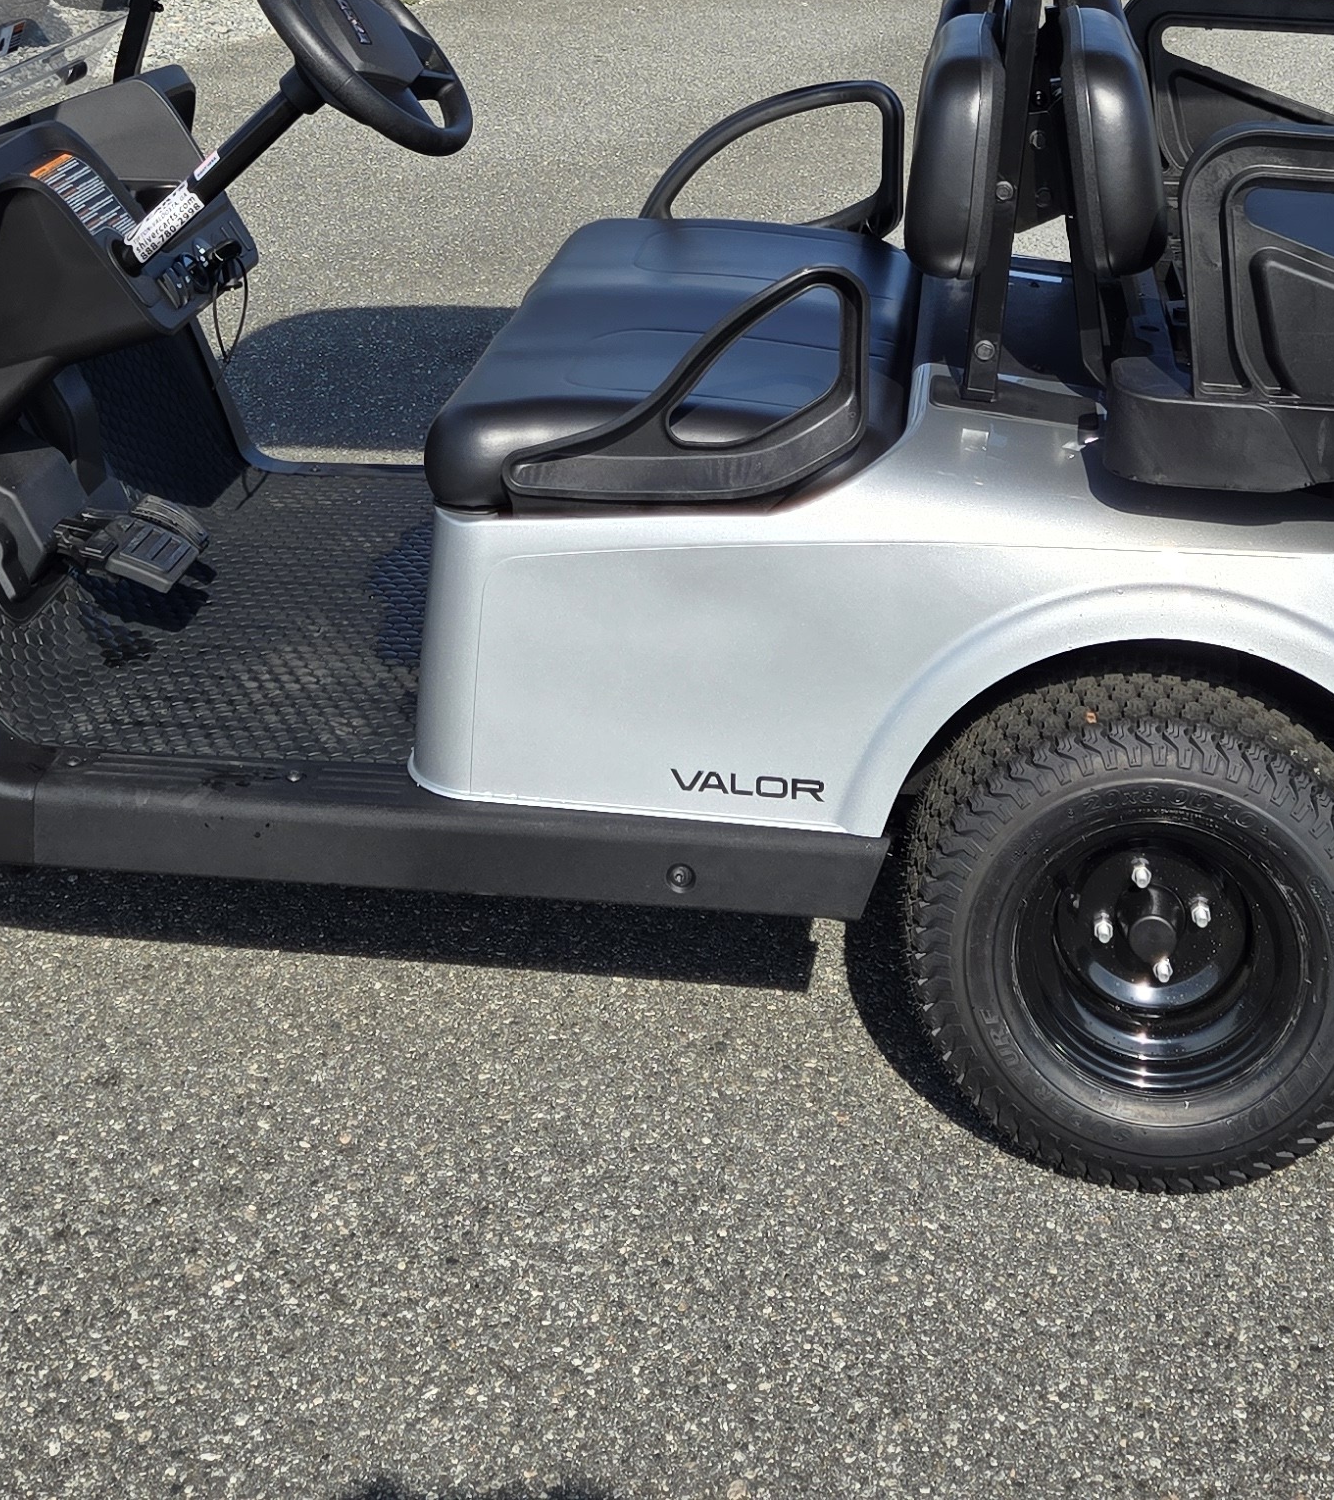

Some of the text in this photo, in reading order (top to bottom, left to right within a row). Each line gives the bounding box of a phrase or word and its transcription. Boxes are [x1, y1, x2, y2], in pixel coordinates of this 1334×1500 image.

[134, 194, 197, 253] shivercarts.com
[139, 201, 202, 261] 888-780-2998
[670, 768, 825, 803] VALOR
